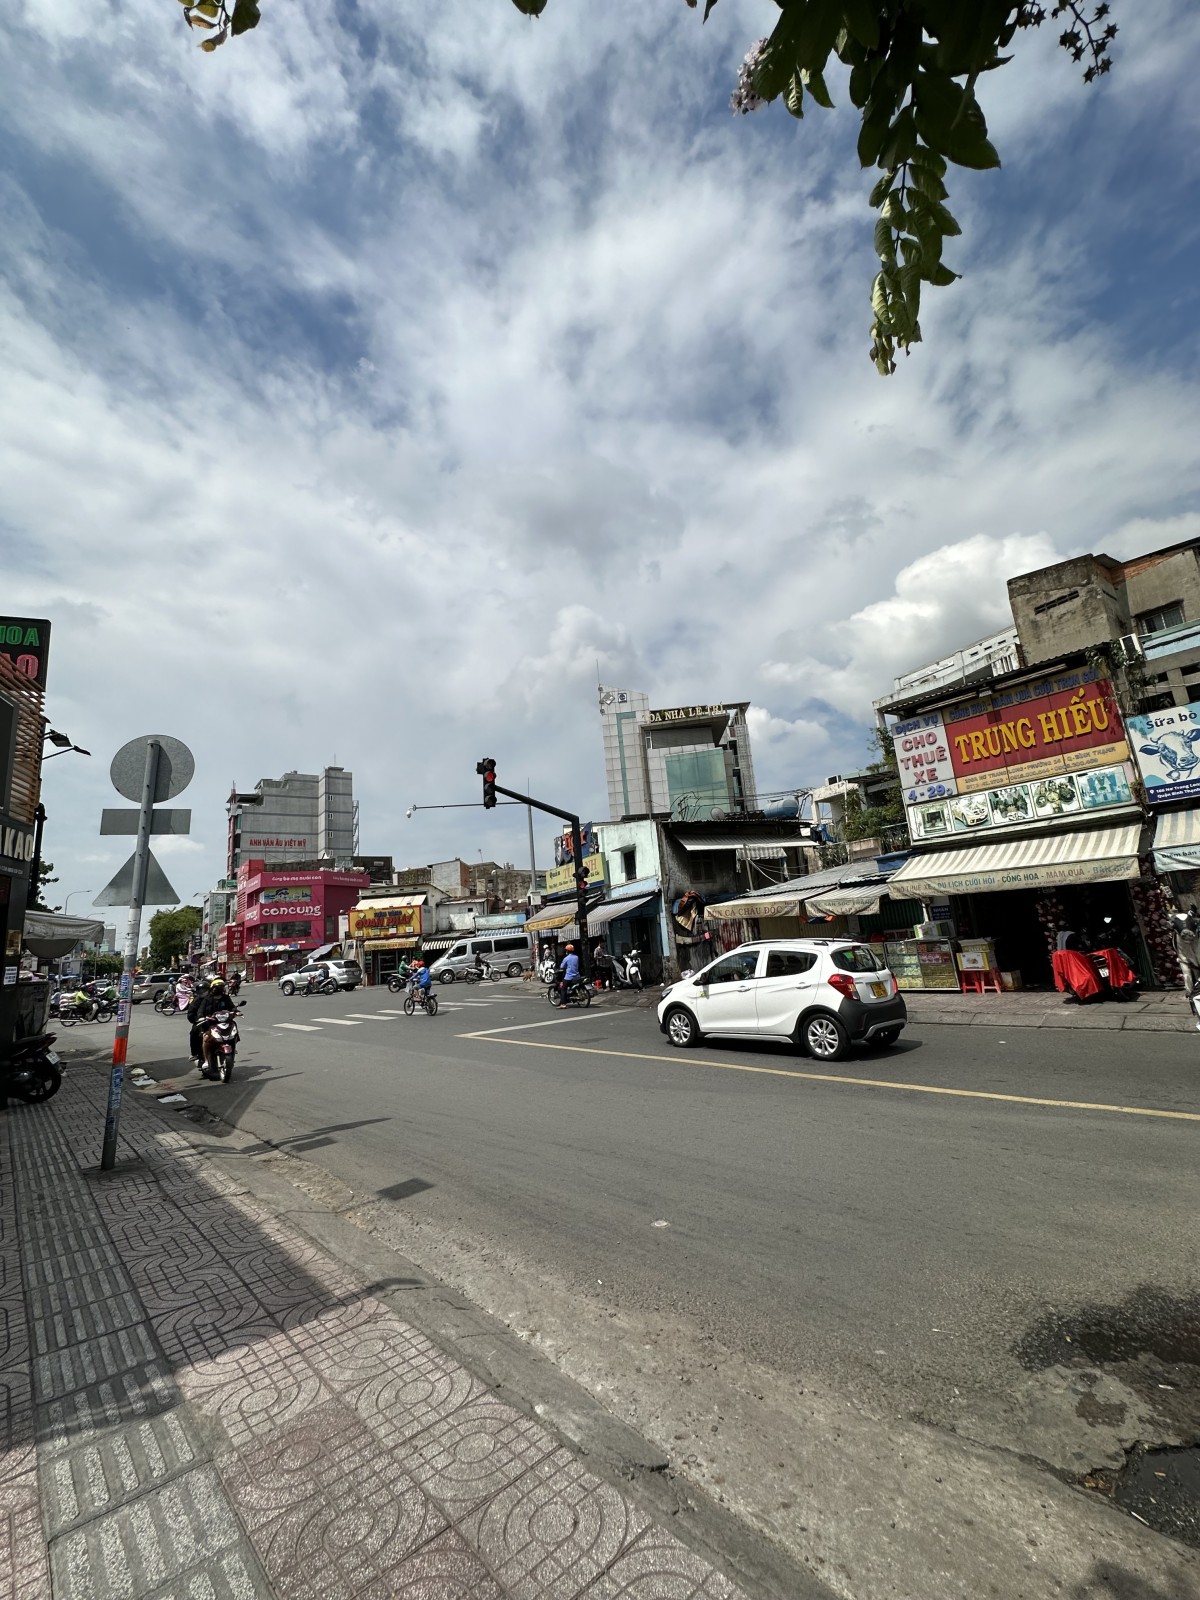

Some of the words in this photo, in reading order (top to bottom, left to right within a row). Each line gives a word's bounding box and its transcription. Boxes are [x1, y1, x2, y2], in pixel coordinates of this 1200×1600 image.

[895, 720, 920, 737] DỊCH
[922, 712, 939, 728] VỤ
[954, 717, 1037, 765] TRUNG
[1037, 688, 1110, 744] HIẾU
[1146, 717, 1175, 730] Sữa
[1179, 710, 1198, 722] bò
[902, 732, 937, 752] CHO
[900, 745, 948, 770] THUÊ
[914, 768, 939, 785] XE
[908, 789, 918, 802] 4
[0, 826, 33, 862] KAO
[250, 839, 262, 847] ANH
[1024, 872, 1039, 881] HOA
